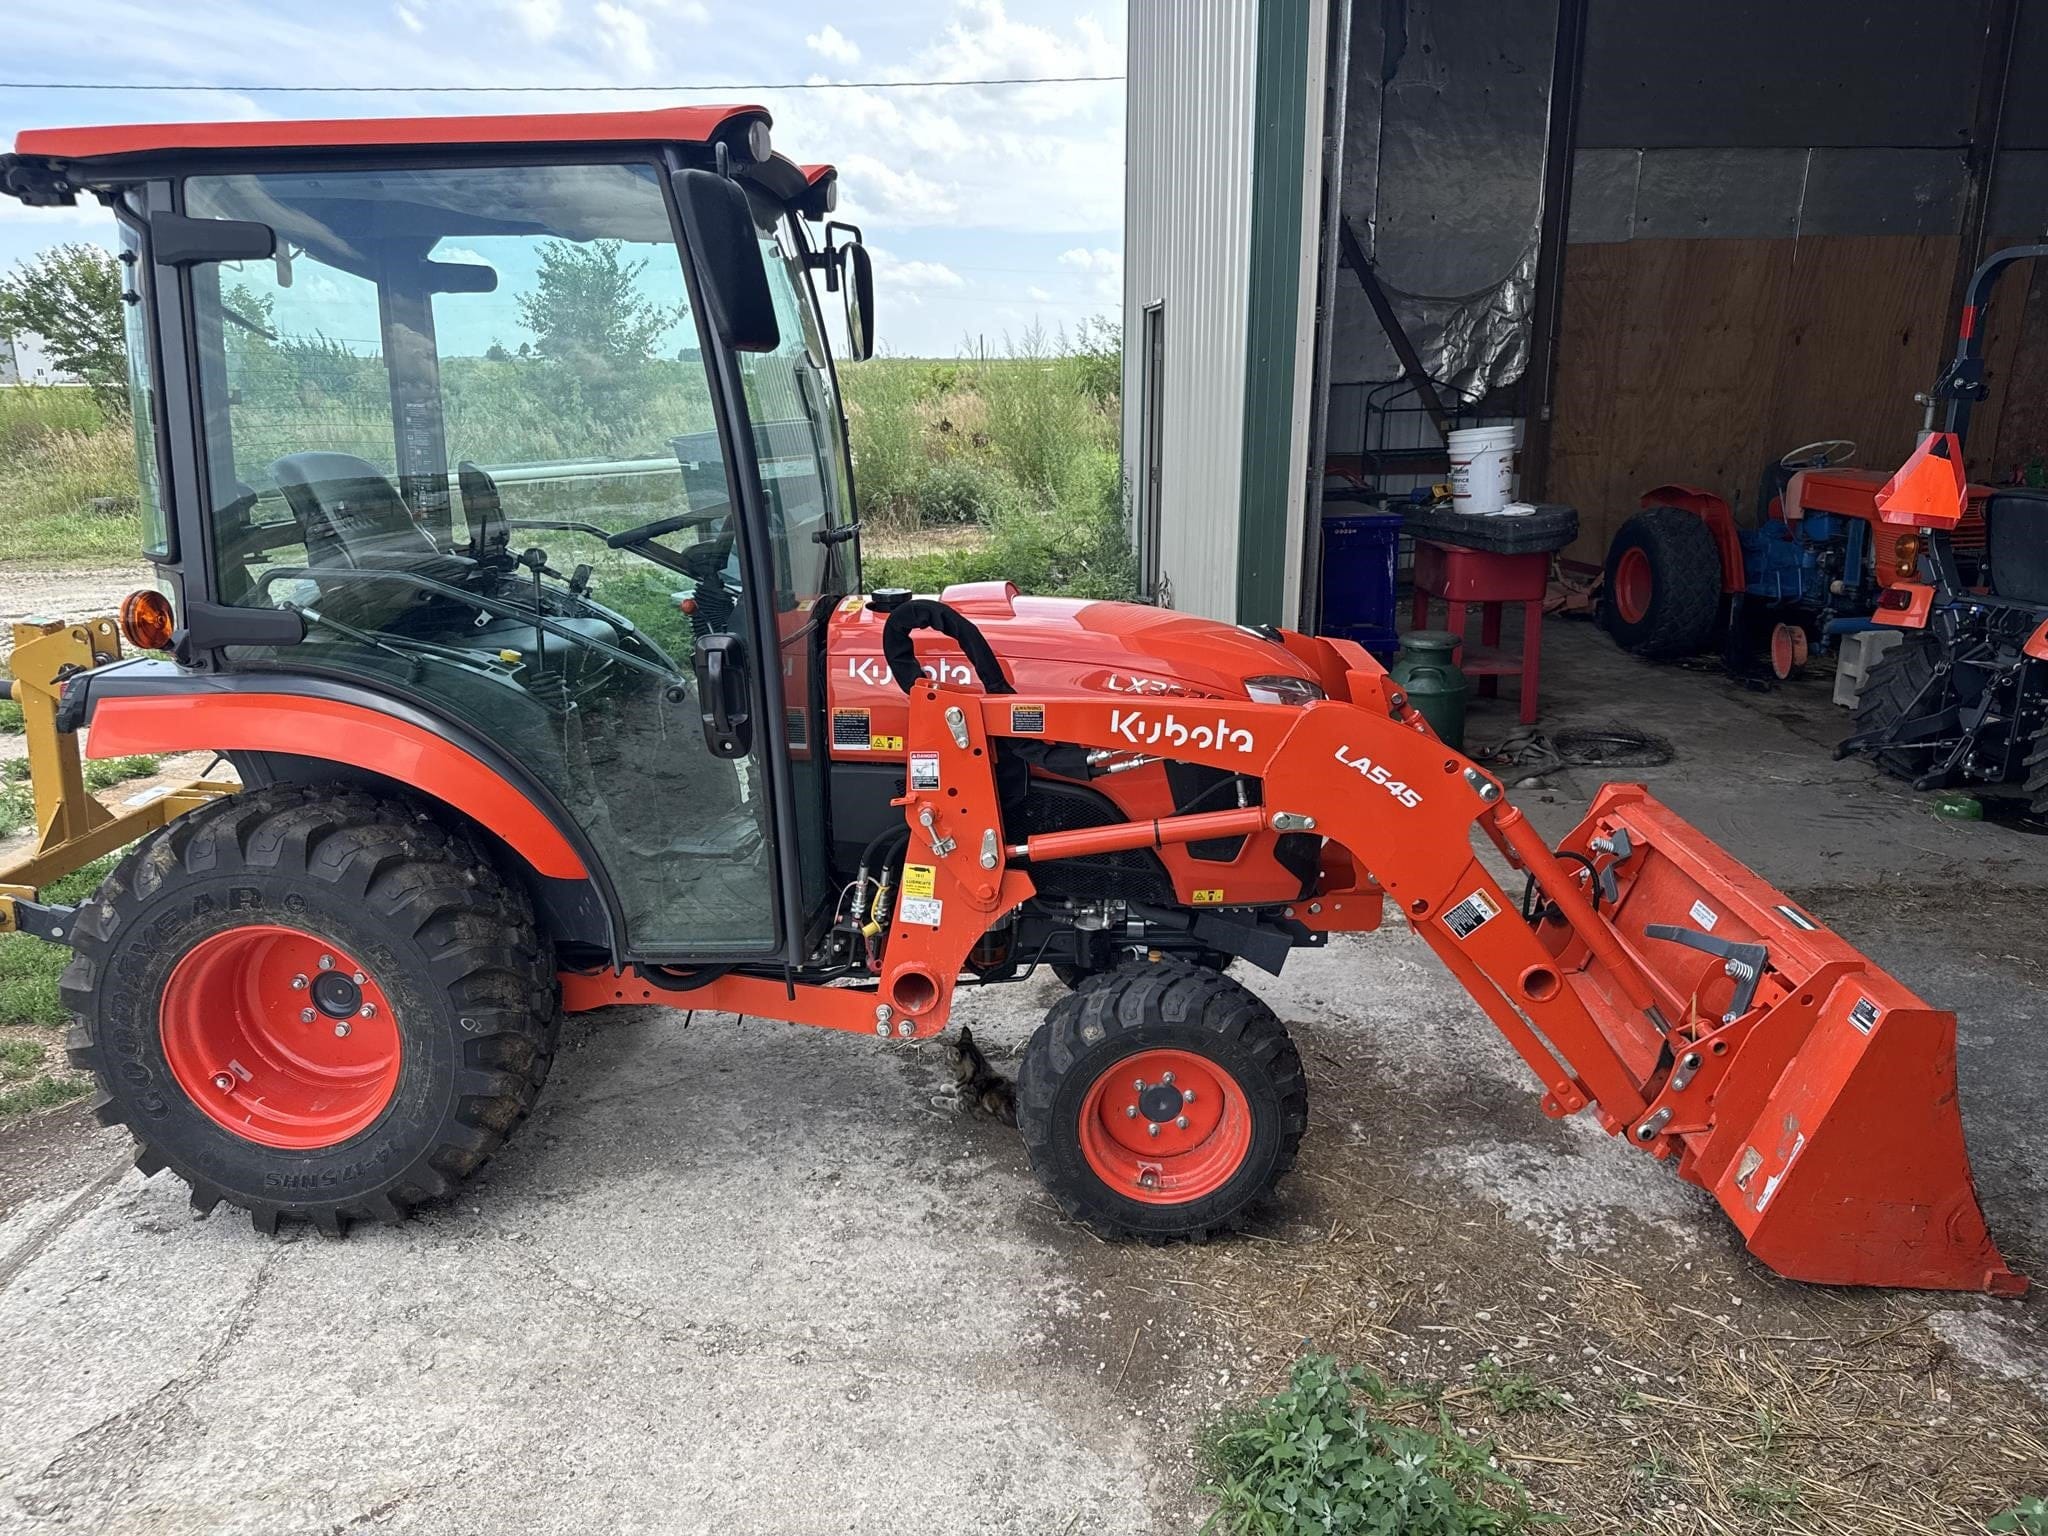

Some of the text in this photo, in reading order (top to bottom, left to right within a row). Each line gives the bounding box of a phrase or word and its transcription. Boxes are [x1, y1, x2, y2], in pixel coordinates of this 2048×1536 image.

[849, 657, 971, 685] Kuota
[1110, 709, 1254, 753] Kubota
[1334, 744, 1424, 808] LA545
